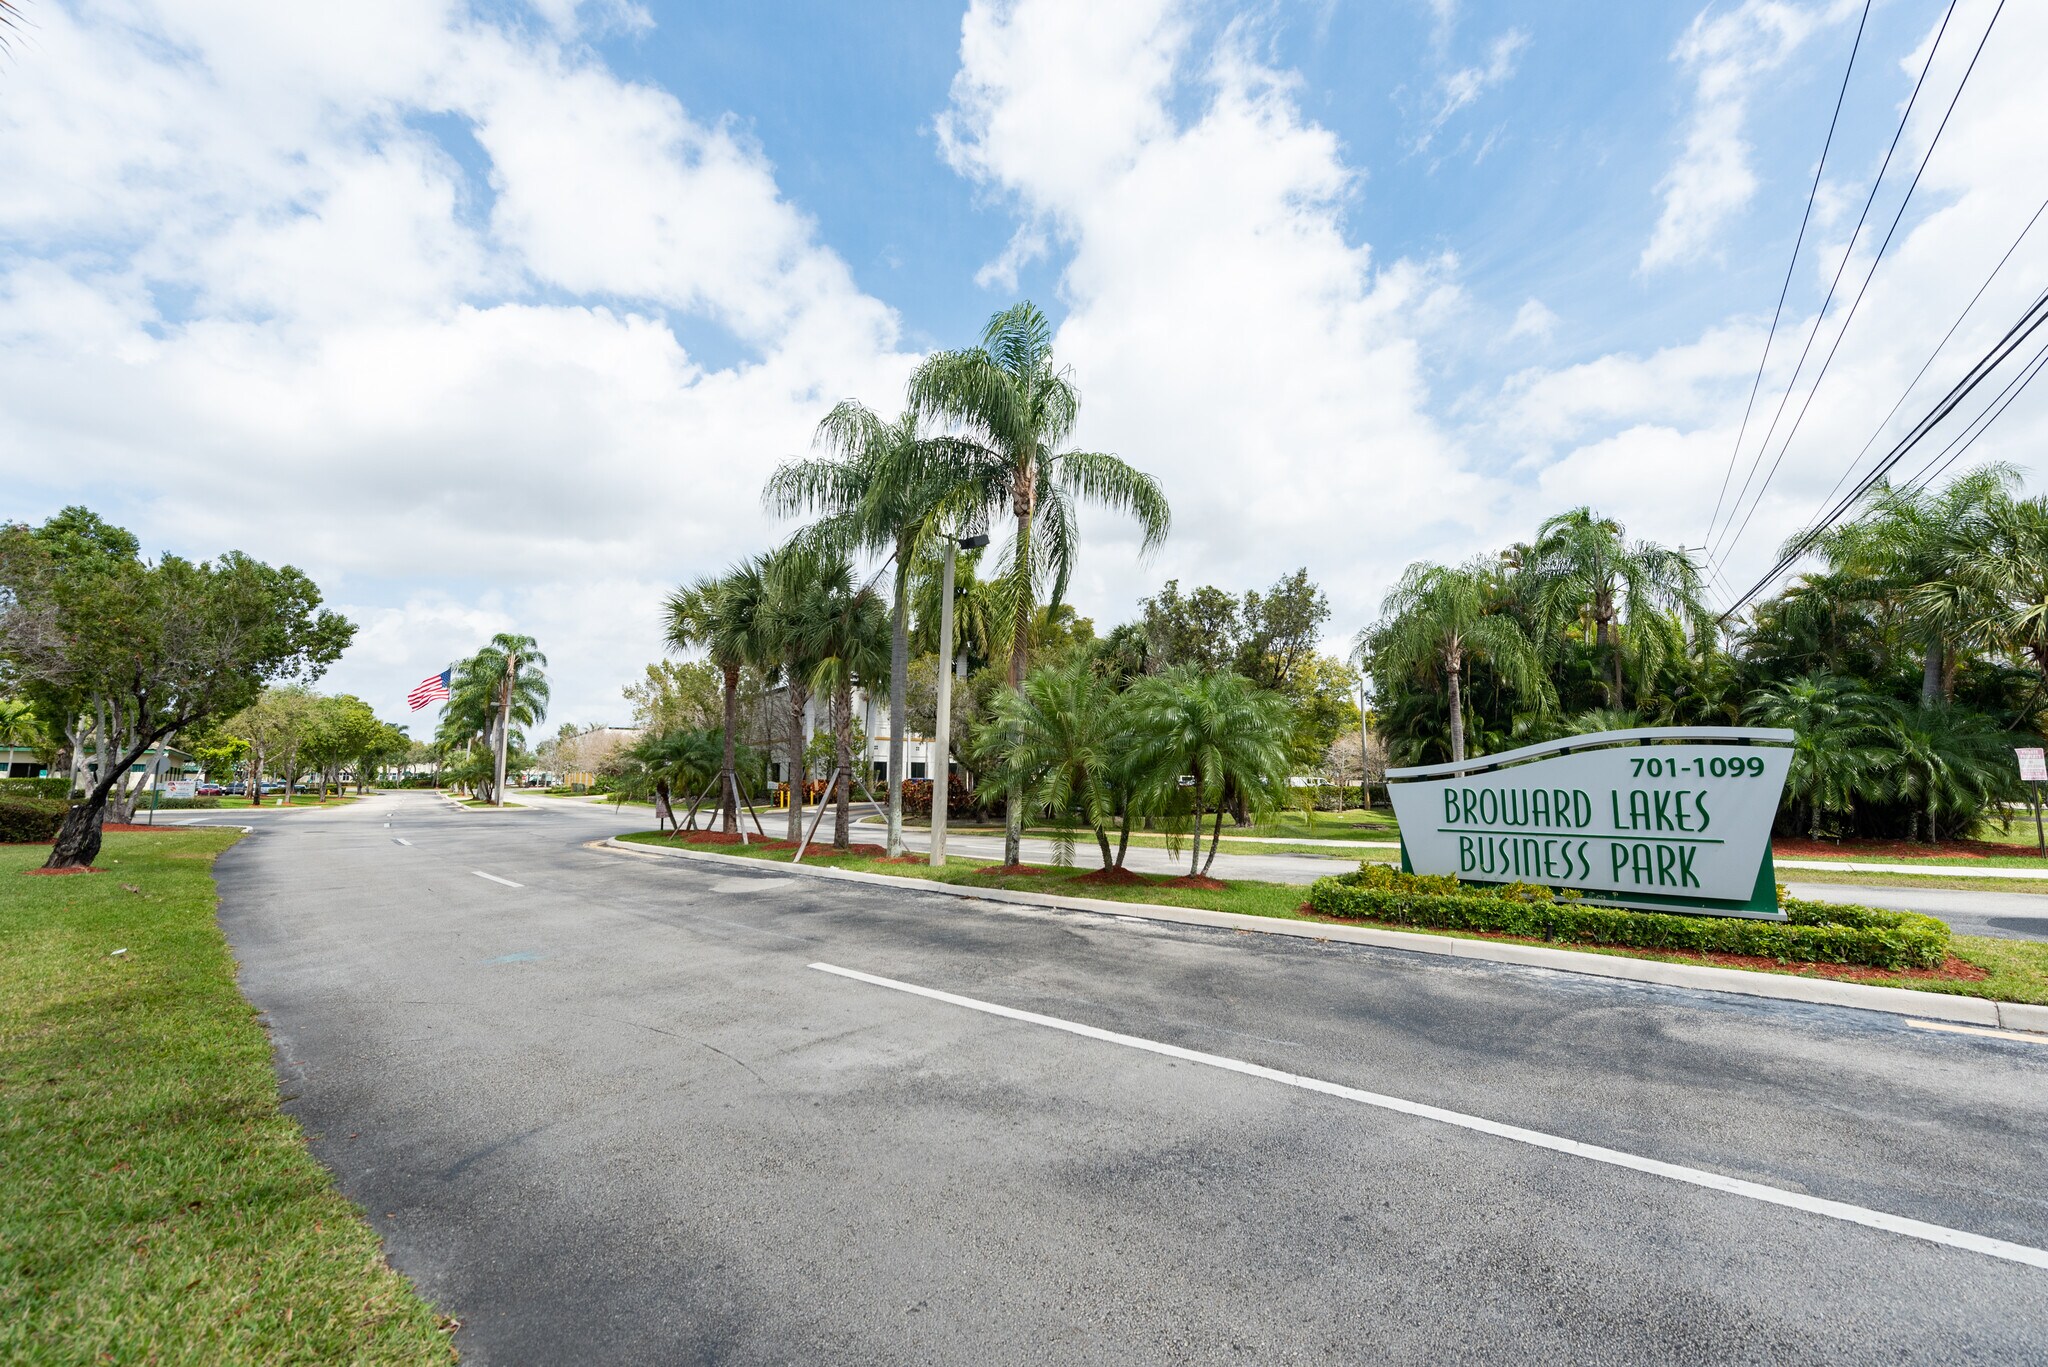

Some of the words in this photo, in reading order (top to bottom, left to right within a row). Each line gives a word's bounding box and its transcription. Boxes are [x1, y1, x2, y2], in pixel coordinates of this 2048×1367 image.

[1630, 757, 1764, 778] 701-1099
[1444, 788, 1592, 828] BROWARD
[1612, 789, 1710, 833] LAKES
[1459, 835, 1590, 881] BUSINESS
[1611, 842, 1699, 888] PARK
